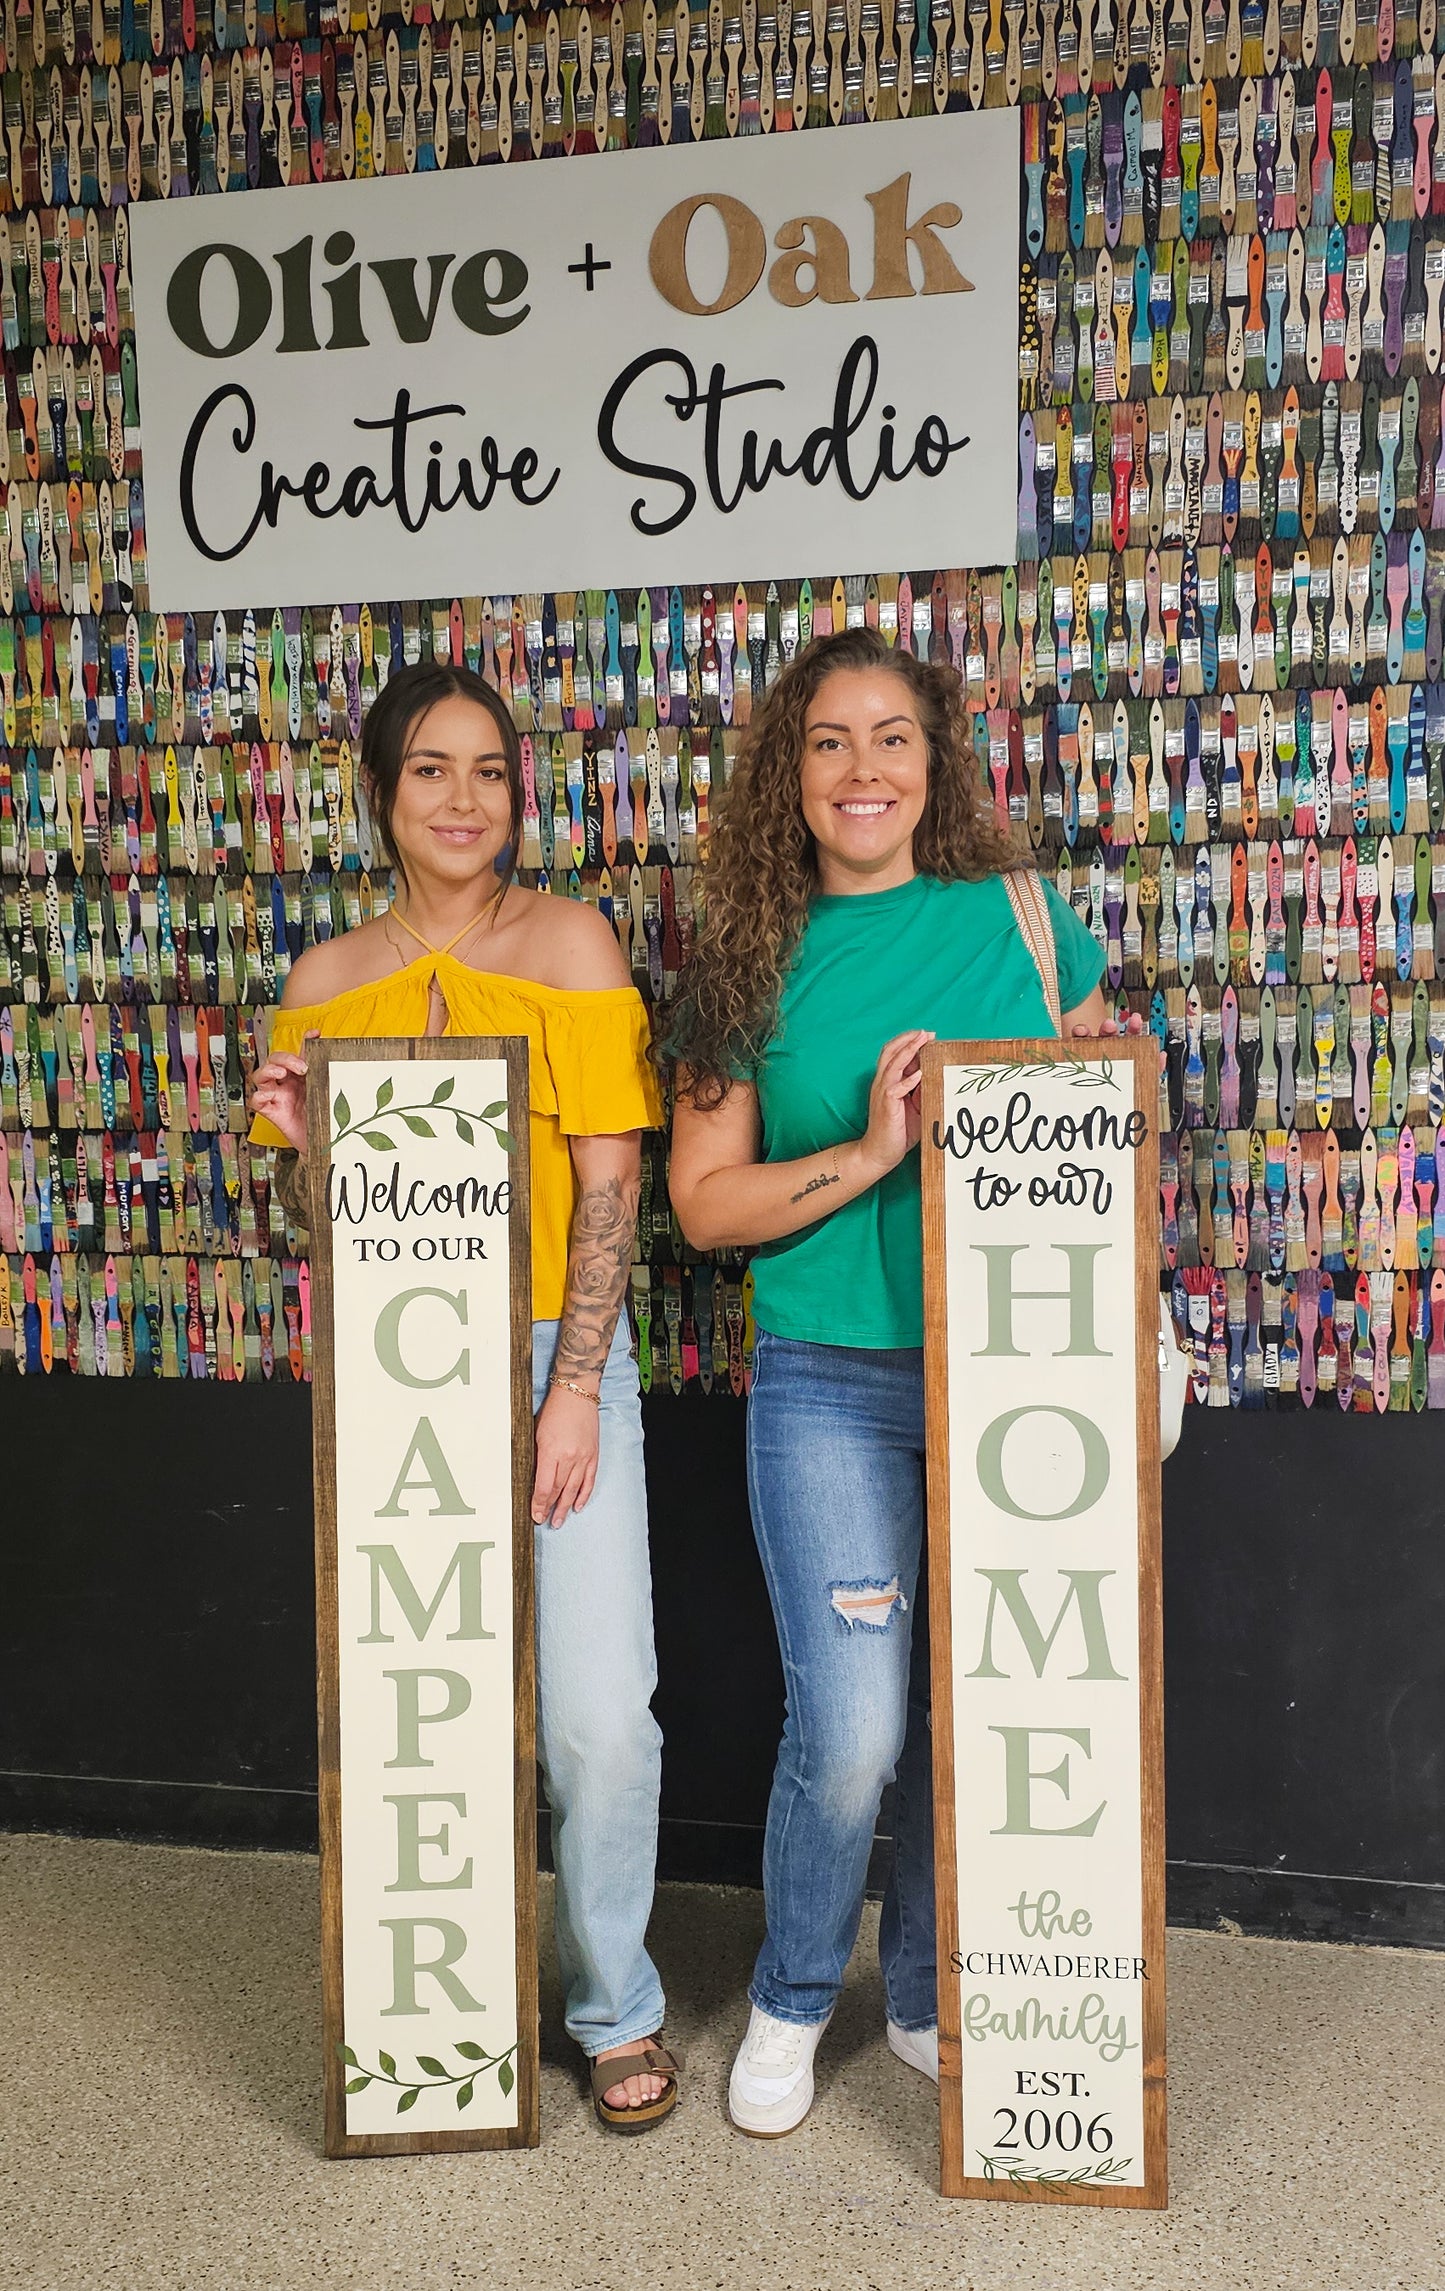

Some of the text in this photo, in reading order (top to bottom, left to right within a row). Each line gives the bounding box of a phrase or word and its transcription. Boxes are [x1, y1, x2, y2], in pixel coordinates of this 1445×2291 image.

[1380, 7, 1391, 34] Smile
[1127, 144, 1137, 181] Carmen
[167, 230, 531, 359] Olive
[648, 171, 977, 317] Oak
[180, 335, 971, 562] Creative Studio
[1096, 443, 1109, 473] Rita
[1134, 443, 1143, 486] WALDEN
[584, 753, 598, 806] YINZ
[587, 815, 601, 862] Anna
[932, 1091, 1149, 1160] welcome
[325, 1162, 513, 1225] Welcome
[966, 1163, 1112, 1215] to our
[353, 1237, 488, 1262] TO OUR
[964, 1243, 1129, 1837] HOME
[356, 1286, 496, 2017] CAMPER
[1006, 1890, 1092, 1940] the
[949, 1951, 1151, 1982] SCHWADERER
[963, 1993, 1139, 2063] family
[1014, 2070, 1091, 2098] EST.
[993, 2107, 1113, 2154] 2006
